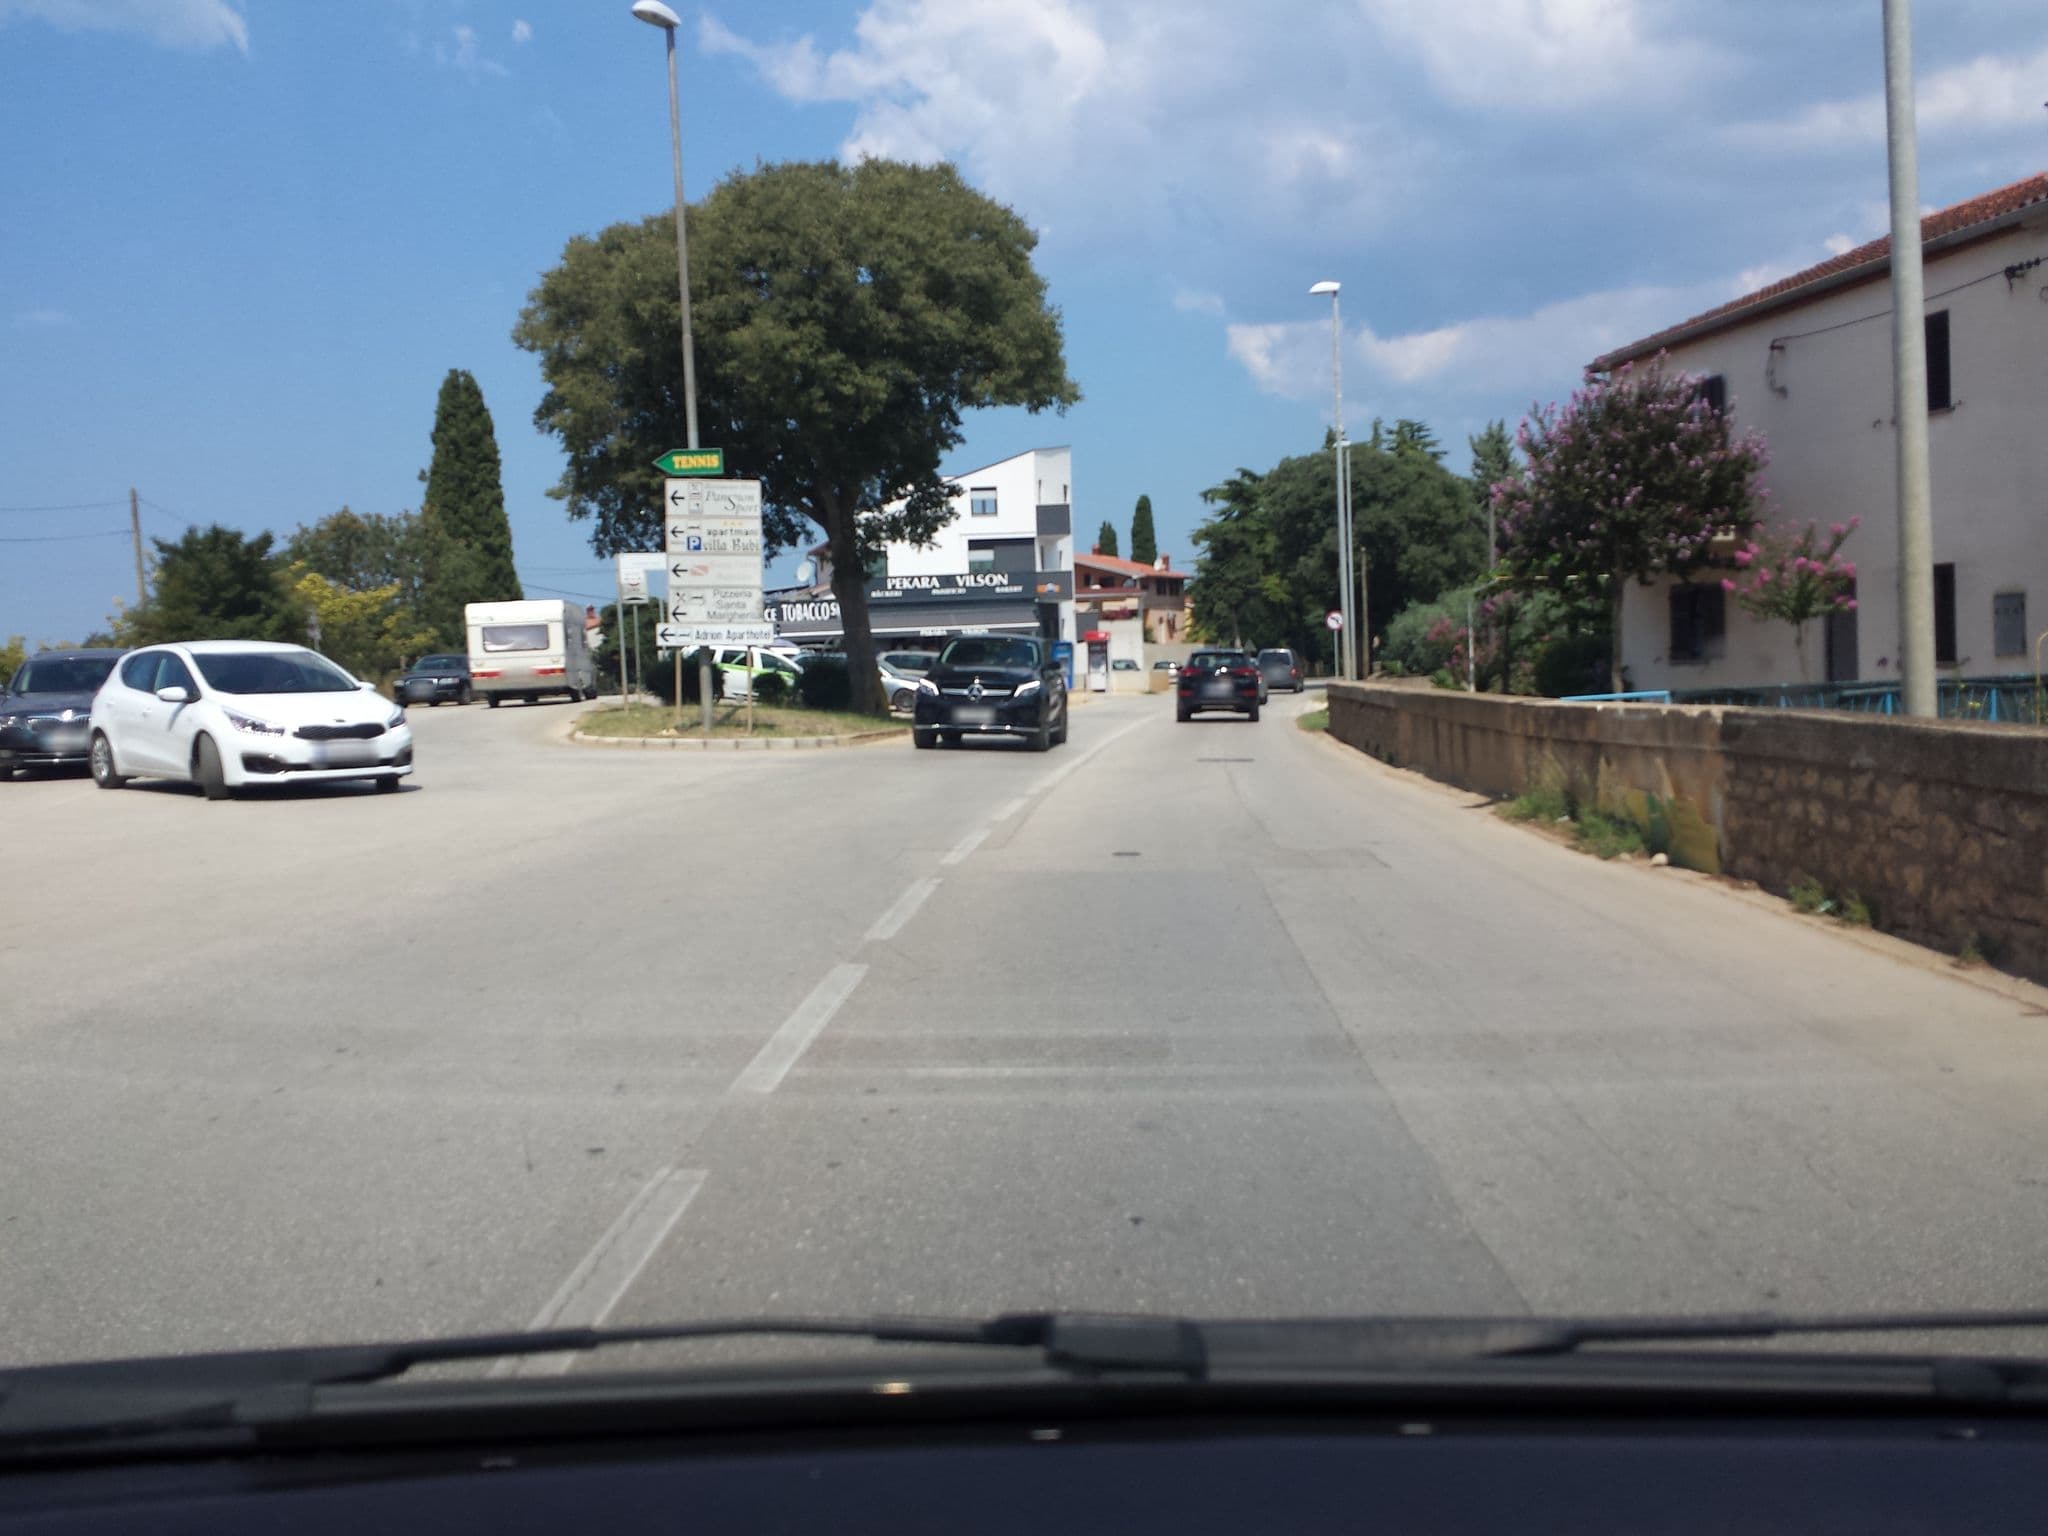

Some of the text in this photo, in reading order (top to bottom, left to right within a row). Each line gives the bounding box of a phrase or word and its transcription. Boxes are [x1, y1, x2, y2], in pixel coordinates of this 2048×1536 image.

[672, 454, 719, 469] TENNIS
[887, 573, 1009, 590] PEKARA VILSON
[713, 589, 752, 598] Pizzeria
[781, 601, 830, 622] TOBACCO
[726, 629, 771, 641] Aparthotel
